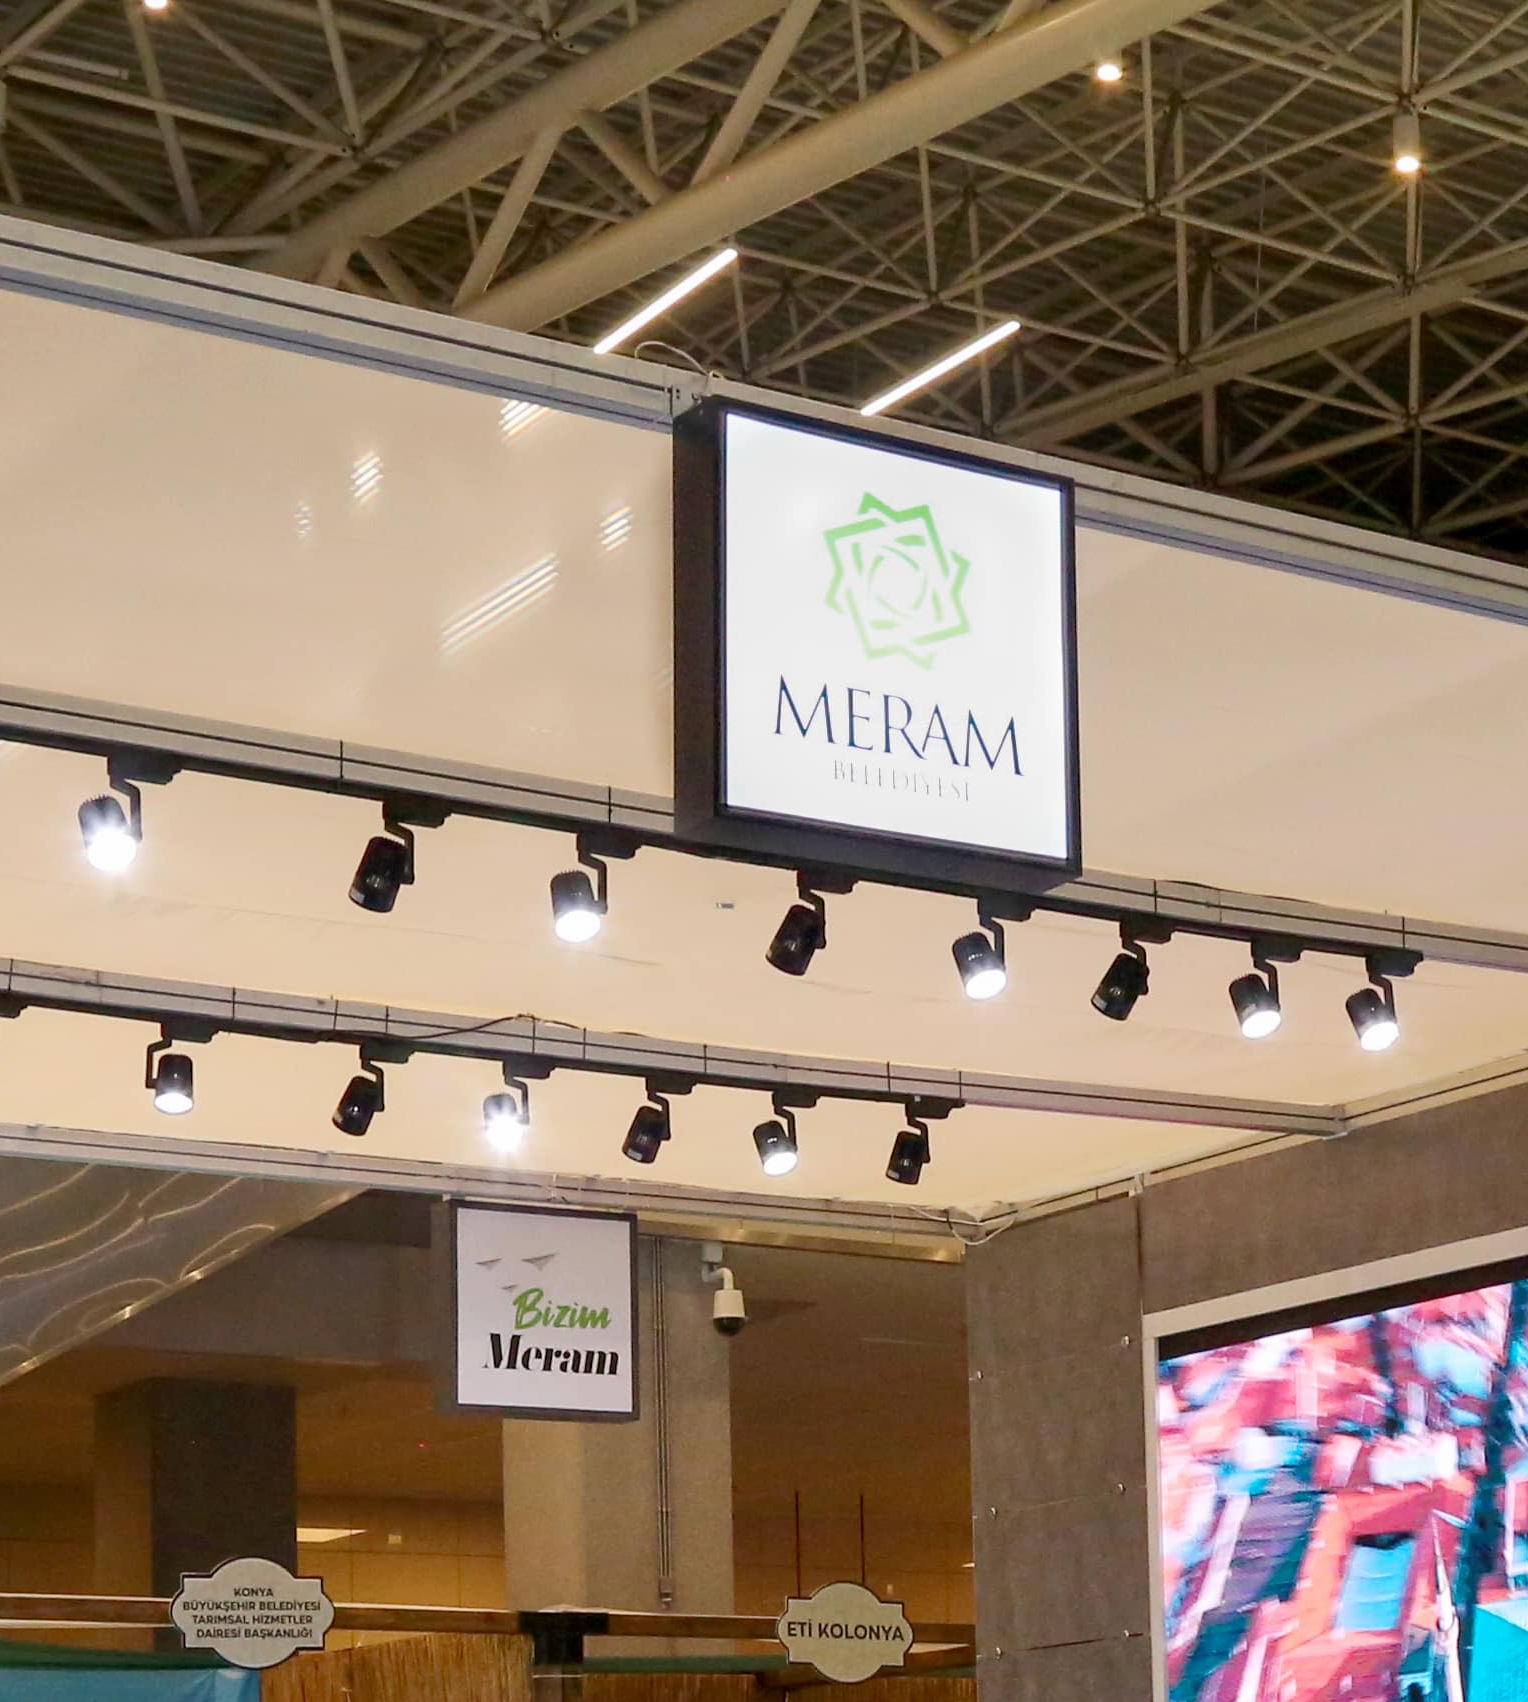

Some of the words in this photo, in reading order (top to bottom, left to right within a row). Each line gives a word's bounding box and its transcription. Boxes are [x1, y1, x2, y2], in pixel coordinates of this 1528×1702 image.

[773, 674, 1025, 777] MERAM
[512, 1287, 611, 1330] Bizim
[481, 1332, 620, 1376] Meram
[233, 1587, 274, 1597] KONYA
[183, 1600, 256, 1613] BÜYÜKŞEHİR
[192, 1614, 249, 1625] TARIMSAL
[196, 1628, 241, 1638] DAİRESİ
[244, 1628, 313, 1640] BAŞKANLIĞI
[787, 1618, 812, 1638] ETİ
[818, 1622, 905, 1641] KOLONYA
